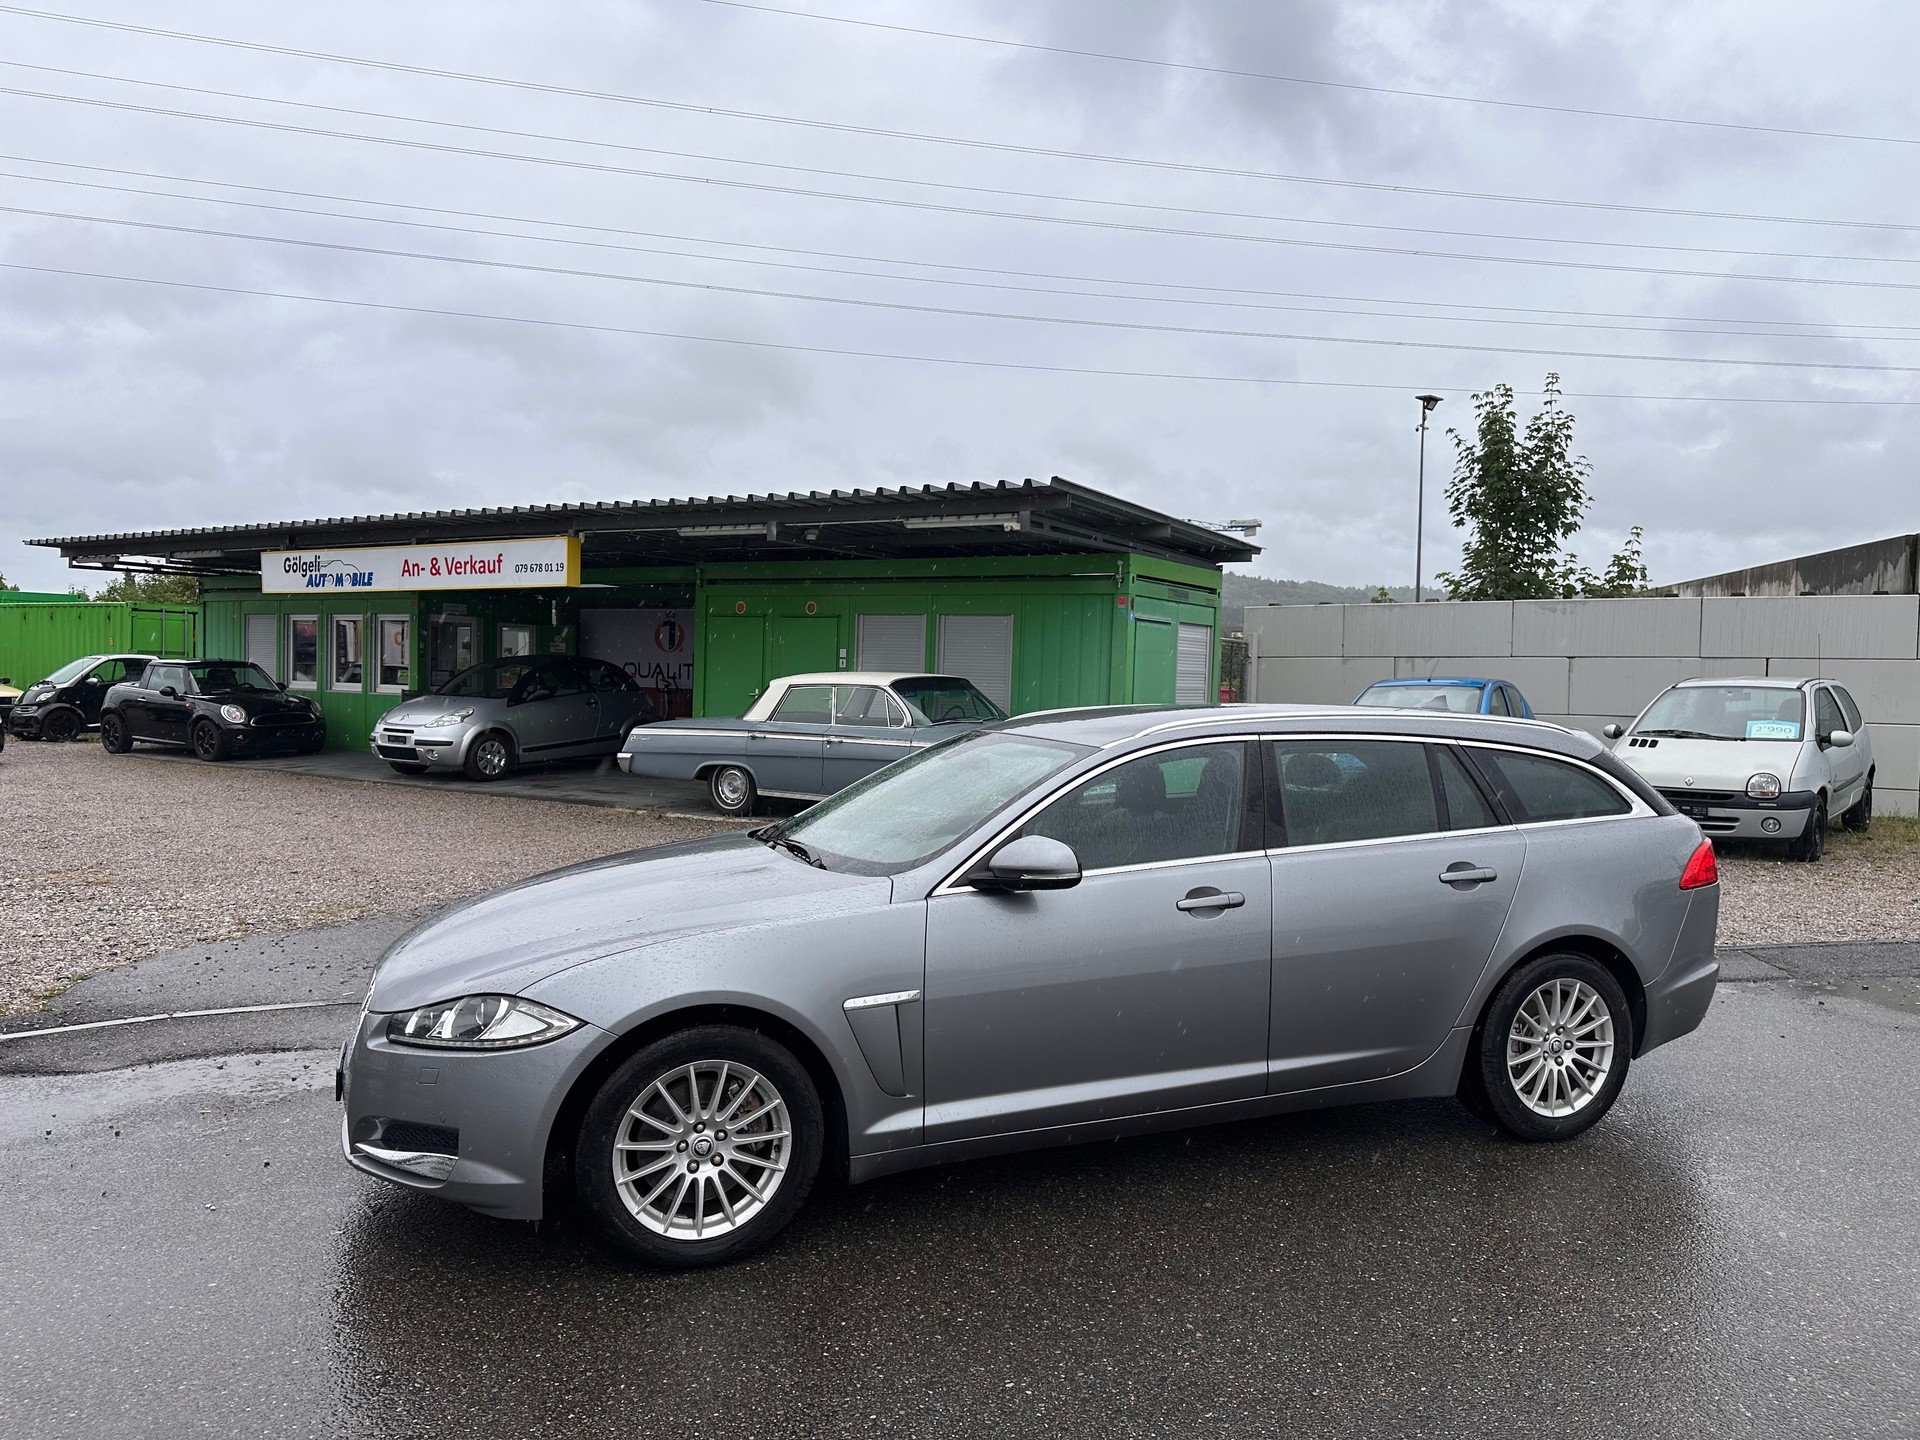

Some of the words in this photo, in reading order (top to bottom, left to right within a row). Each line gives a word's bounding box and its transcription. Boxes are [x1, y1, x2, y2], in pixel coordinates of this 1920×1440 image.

[283, 555, 320, 578] Gölgeli
[401, 559, 426, 577] An-
[429, 557, 442, 576] &
[444, 553, 503, 576] Verkauf
[515, 563, 528, 573] 079
[529, 563, 543, 573] 678
[544, 563, 553, 572] 01
[555, 562, 565, 572] 19
[853, 993, 912, 1005] JAGUAR
